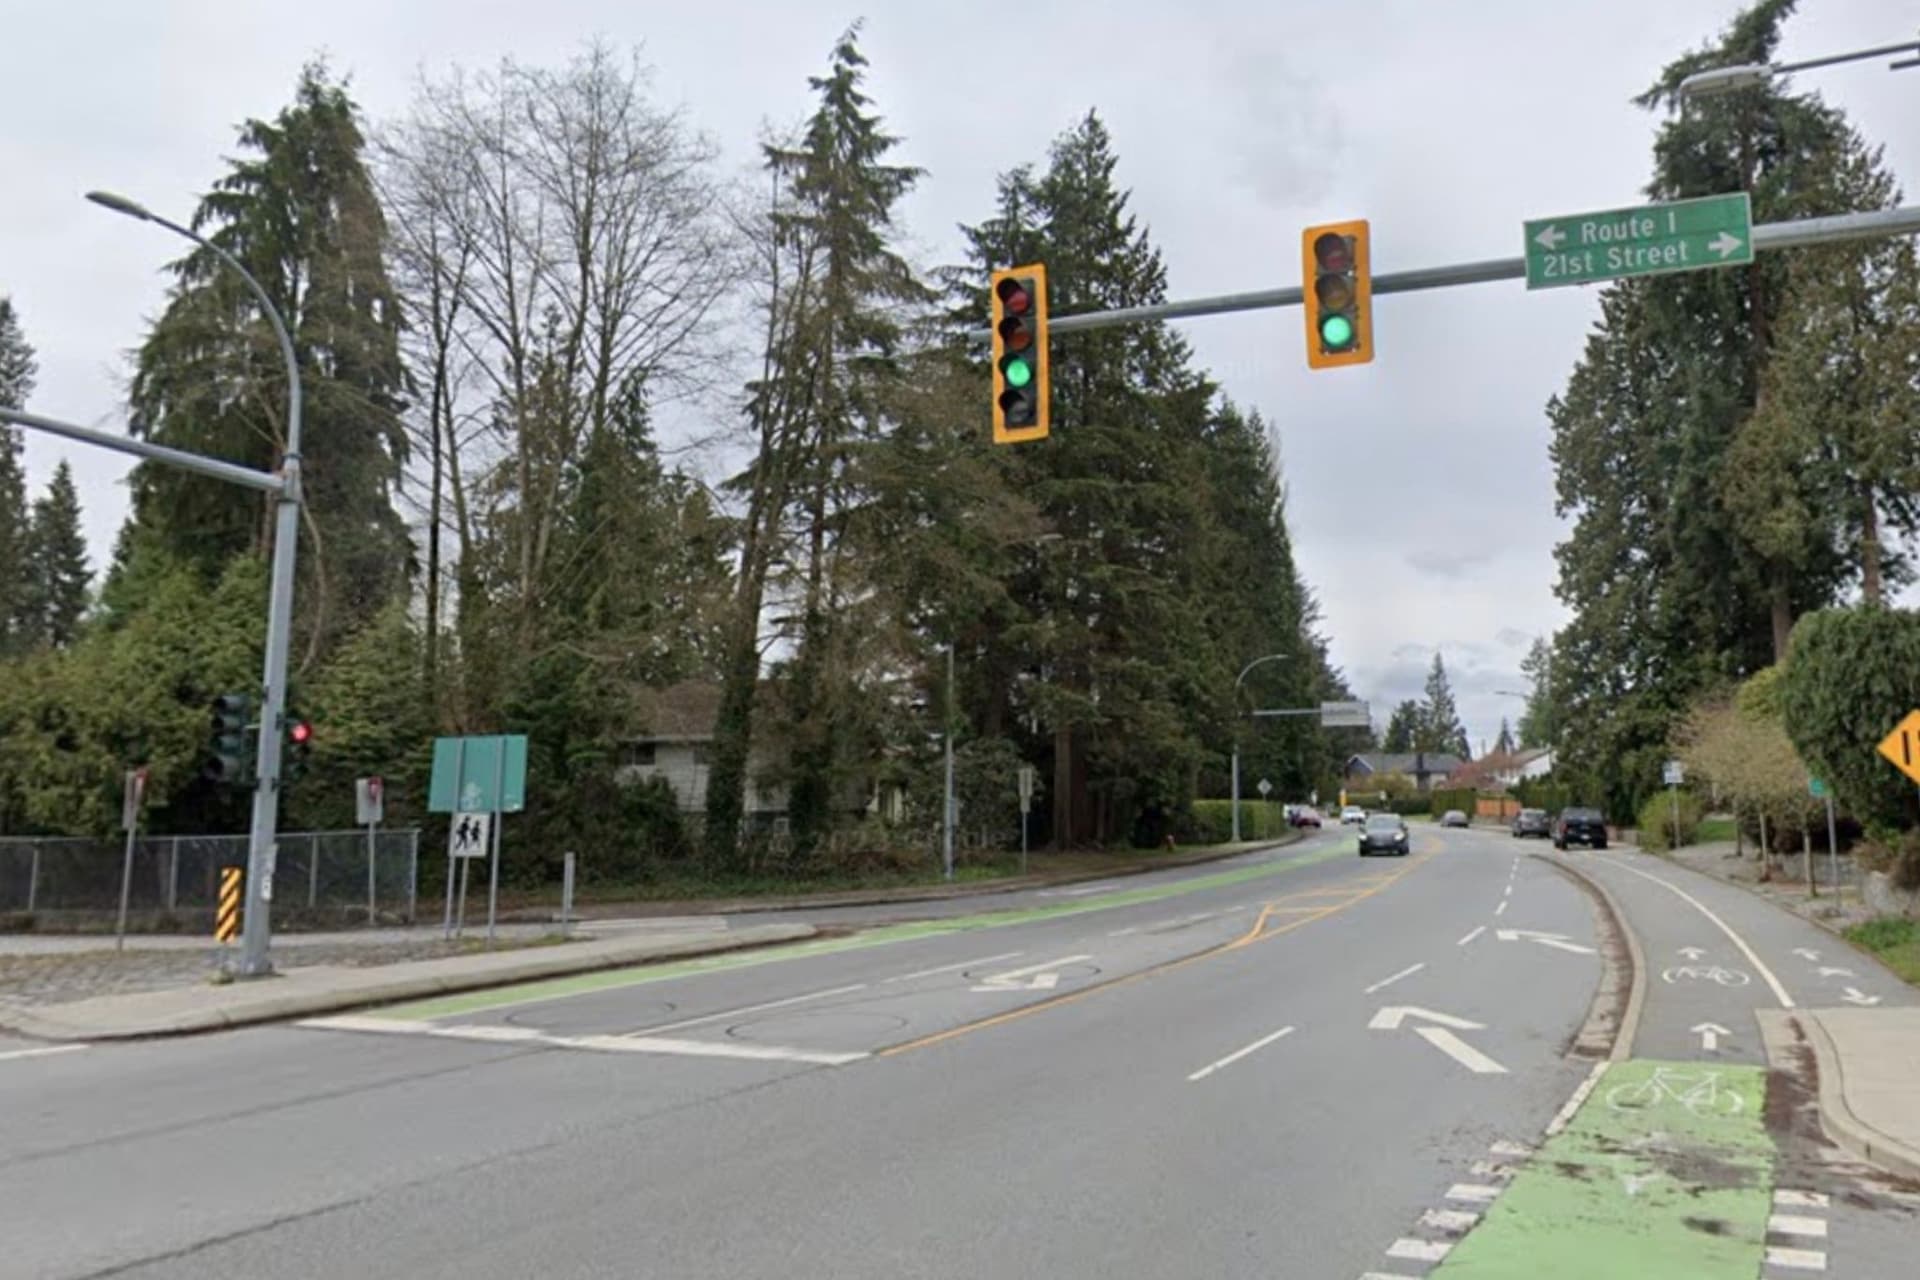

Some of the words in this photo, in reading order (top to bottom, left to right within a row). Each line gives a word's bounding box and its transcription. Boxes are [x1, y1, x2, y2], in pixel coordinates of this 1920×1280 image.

[1581, 217, 1654, 244] Route
[1668, 211, 1676, 234] 1
[1543, 252, 1593, 277] 21st
[1607, 240, 1688, 270] Street
